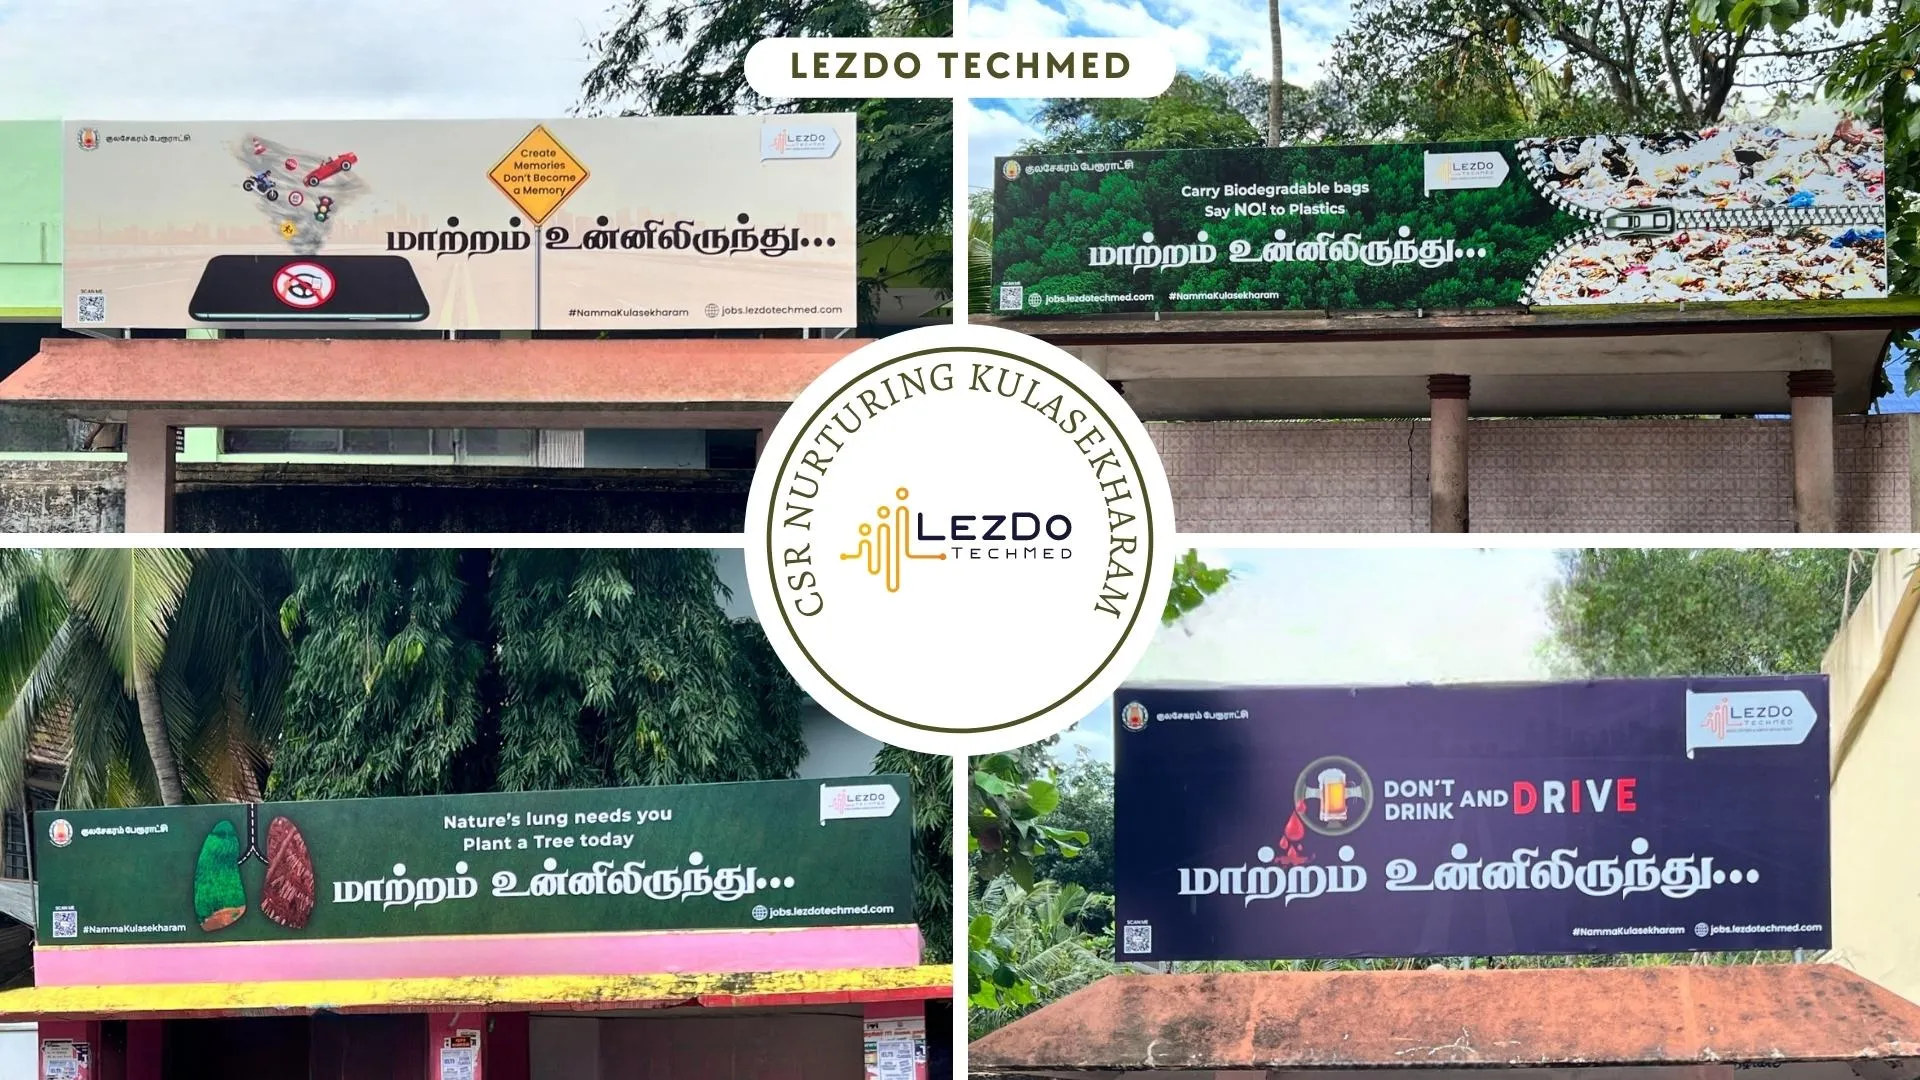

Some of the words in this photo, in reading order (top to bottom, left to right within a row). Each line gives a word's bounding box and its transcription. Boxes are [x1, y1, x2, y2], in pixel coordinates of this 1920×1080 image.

[520, 149, 556, 158] Create
[513, 161, 566, 170] Memories
[1025, 161, 1079, 175] குலசேகரம்
[503, 174, 531, 183] Don't
[533, 173, 576, 182] Become
[513, 187, 521, 195] a
[522, 186, 566, 196] Memory
[1181, 184, 1220, 199] Carry
[1224, 182, 1330, 197] Biodegradable
[1333, 181, 1369, 196] bags
[1205, 205, 1230, 219] Say
[1234, 202, 1267, 217] NO!
[1269, 204, 1286, 216] to
[1288, 202, 1345, 216] Plastics
[385, 216, 531, 261] மாற்றம்
[1088, 230, 1217, 275] மாற்றம்
[1045, 292, 1154, 305] jobs.lezdotechmed.com
[1168, 290, 1279, 301] #NammaKulasekharam
[568, 308, 689, 318] #NammaKulasekharam
[721, 303, 843, 317] jobs.lezdotechmed.com
[1384, 779, 1455, 798] DON'T
[1459, 789, 1508, 808] AND
[1513, 777, 1637, 815] DRIVE
[1385, 802, 1454, 820] DRINK
[443, 812, 520, 829] Nature's
[526, 811, 568, 828] lung
[574, 808, 631, 824] needs
[637, 808, 672, 825] you
[463, 836, 512, 851] Plant
[517, 838, 528, 849] a
[533, 835, 574, 848] Tree
[580, 832, 635, 849] today
[1177, 845, 1368, 908] மாற்றம்
[332, 860, 478, 912] மாற்றம்
[769, 903, 894, 918] jobs.lezdotechmed.com
[83, 923, 186, 934] #NammaKulasekharam
[1572, 925, 1685, 937] #NammaKulasekharam
[1710, 922, 1822, 935] jobs.lezdotechmed.com
